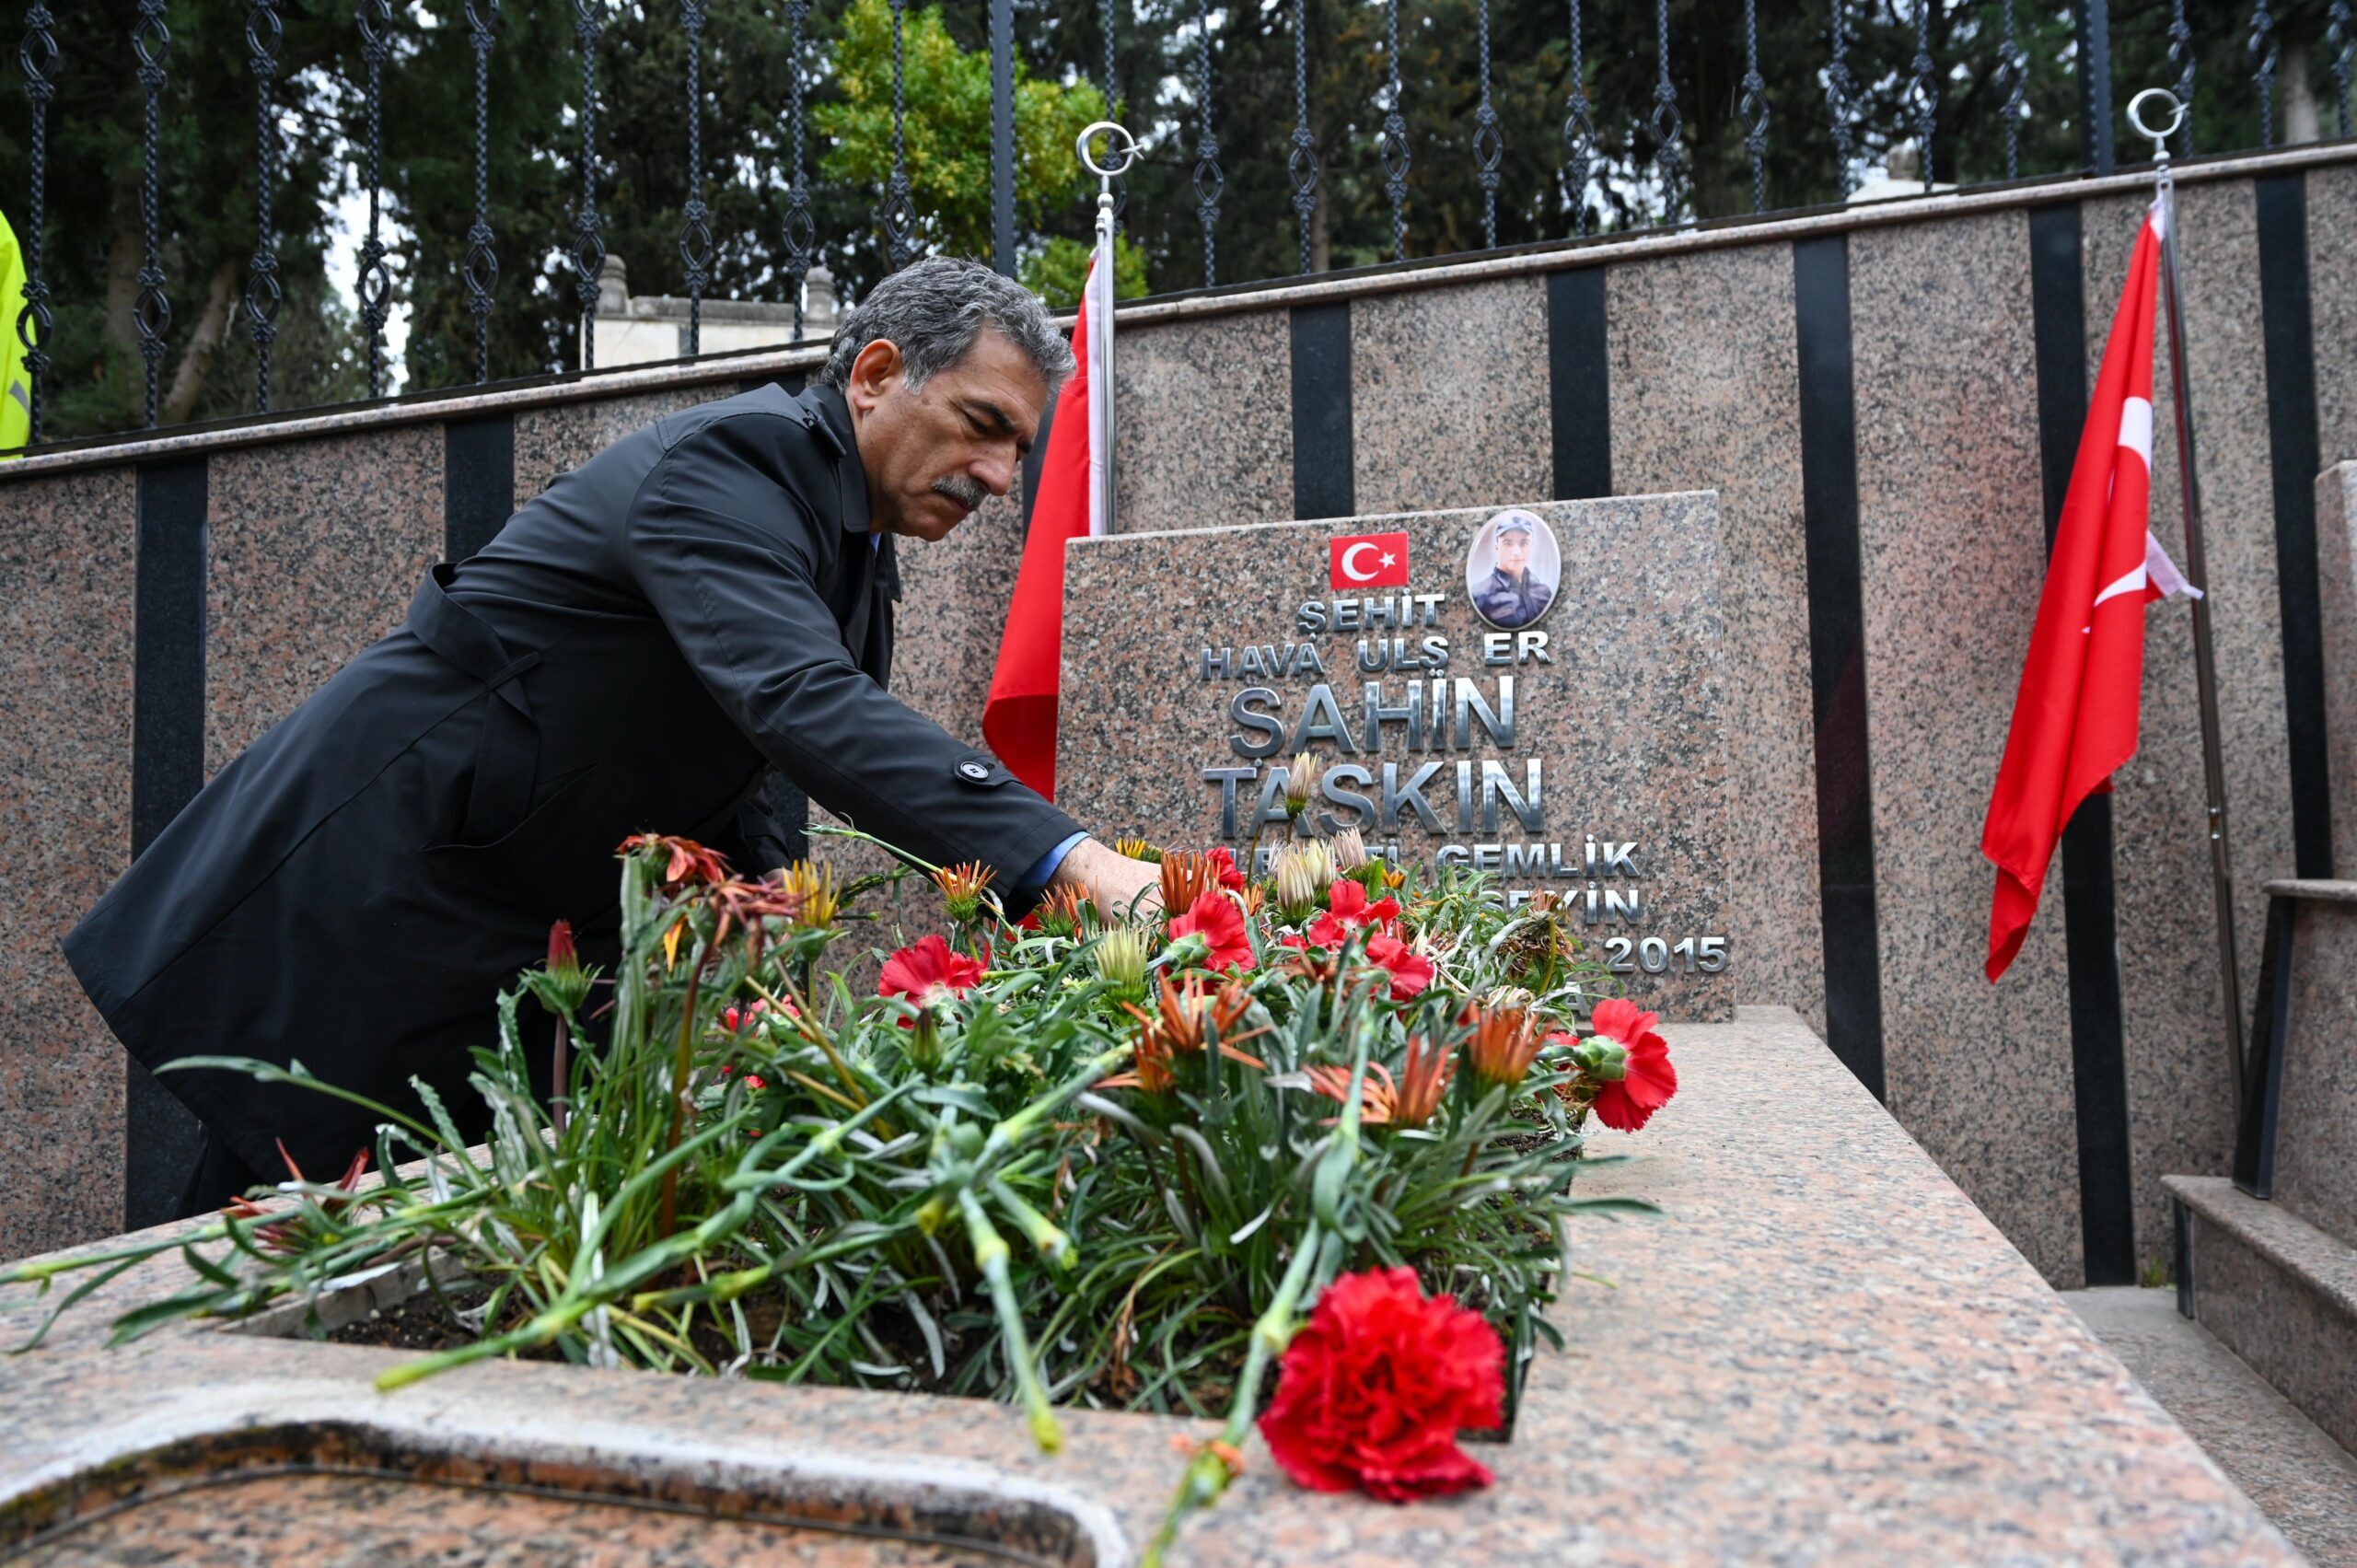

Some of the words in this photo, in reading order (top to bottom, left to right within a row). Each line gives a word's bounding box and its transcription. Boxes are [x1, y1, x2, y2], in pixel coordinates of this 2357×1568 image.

[1201, 643, 1324, 680] HAVA
[1483, 631, 1551, 667] ER
[1436, 833, 1641, 878] GEMLİK
[1604, 936, 1727, 973] 2015
